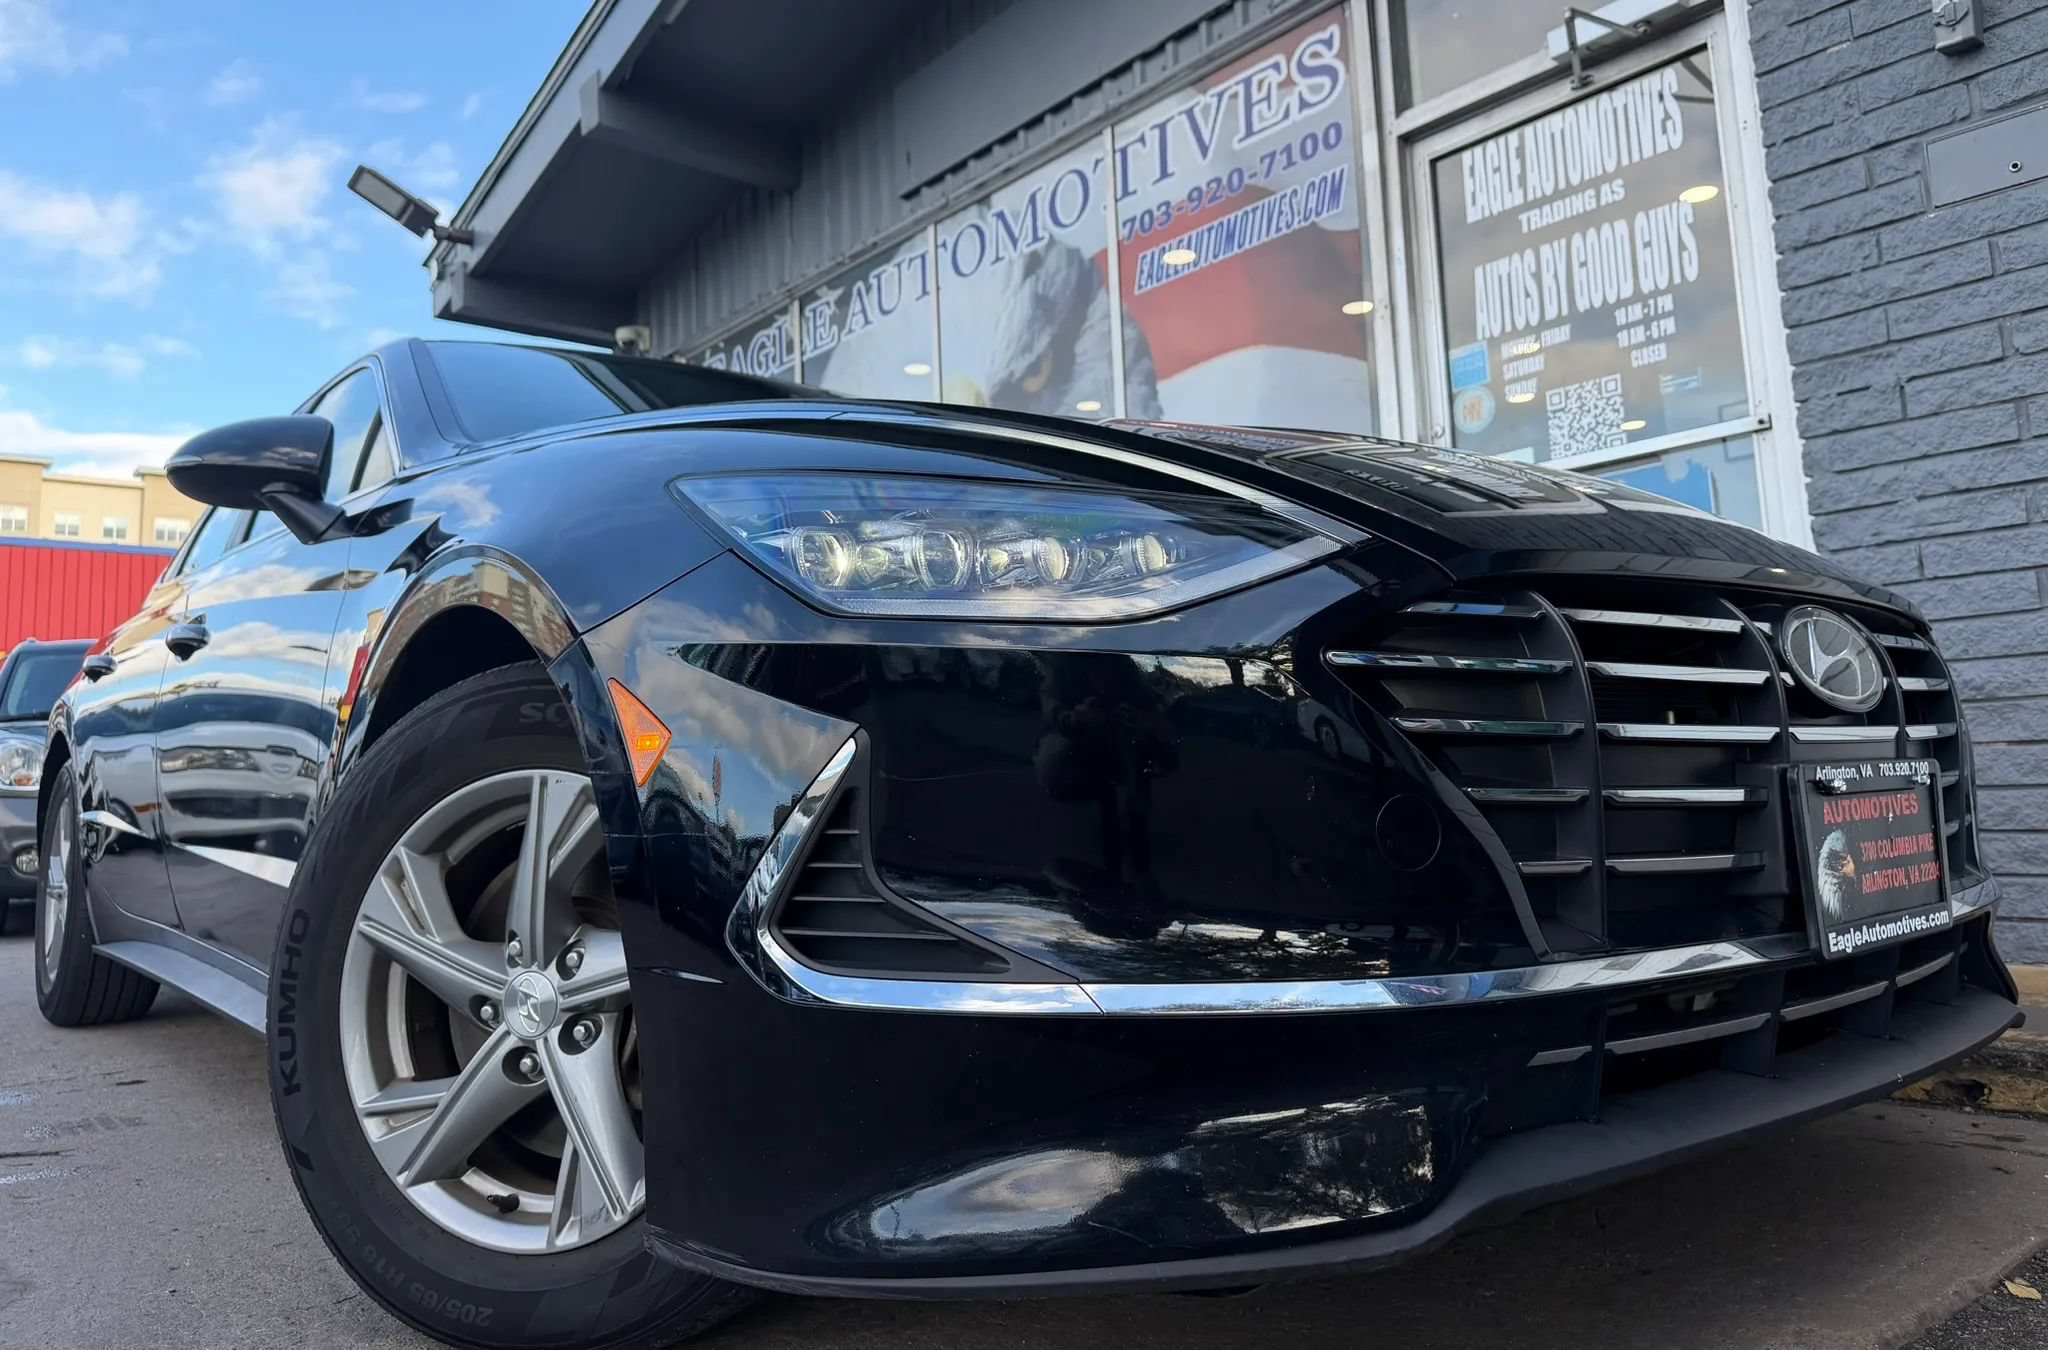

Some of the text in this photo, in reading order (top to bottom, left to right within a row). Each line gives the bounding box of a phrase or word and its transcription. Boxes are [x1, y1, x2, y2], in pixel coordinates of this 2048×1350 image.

[1462, 68, 1685, 224] EAGLE AUTOMOTIVES
[842, 24, 1344, 340] AUTOMOTIVES
[1122, 121, 1344, 244] 703-920-7100
[1518, 178, 1626, 234] TRADING AS
[1134, 164, 1348, 294] EAGLEAUTOMOTIVES.COM
[1474, 201, 1699, 341] AUTOS BY GOOD GUYS
[1630, 341, 1667, 368] CLOSED
[1816, 761, 1930, 781] Arlington, VA 703.920.7100
[1823, 792, 1921, 824] AUTOMOTIVES
[1877, 835, 1918, 859] COLUMBIA
[1917, 832, 1935, 853] PIKE
[1861, 869, 1909, 894] ARLINGTON,
[1909, 865, 1920, 882] VA
[1828, 909, 1950, 953] EagleAutomotives.com
[273, 908, 311, 1096] KUMHO
[407, 1281, 495, 1327] 205/65
